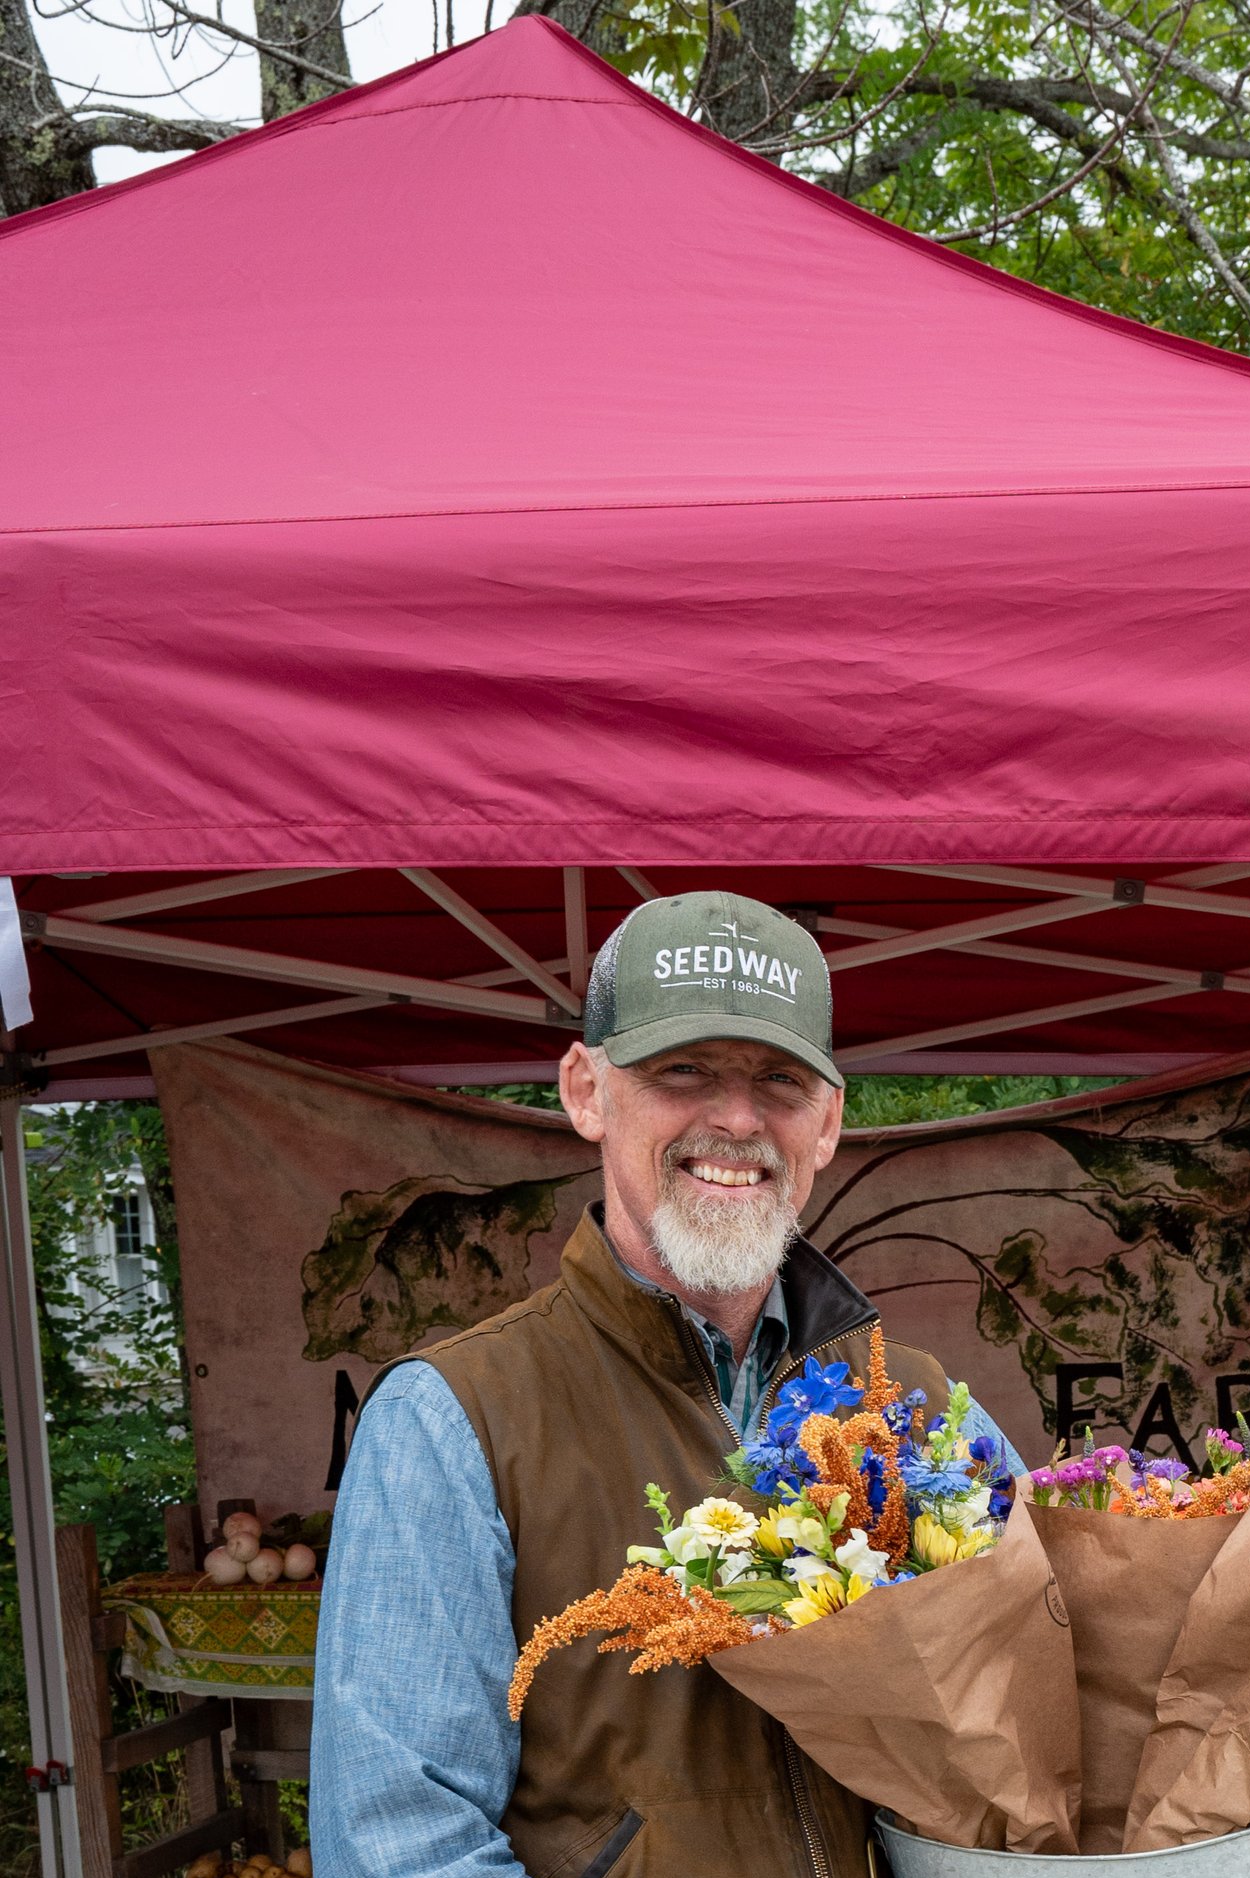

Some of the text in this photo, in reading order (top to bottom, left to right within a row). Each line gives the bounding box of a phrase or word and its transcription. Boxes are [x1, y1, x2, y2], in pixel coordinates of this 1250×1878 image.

[654, 945, 800, 995] SEEDWAY
[703, 977, 761, 995] EST 1963
